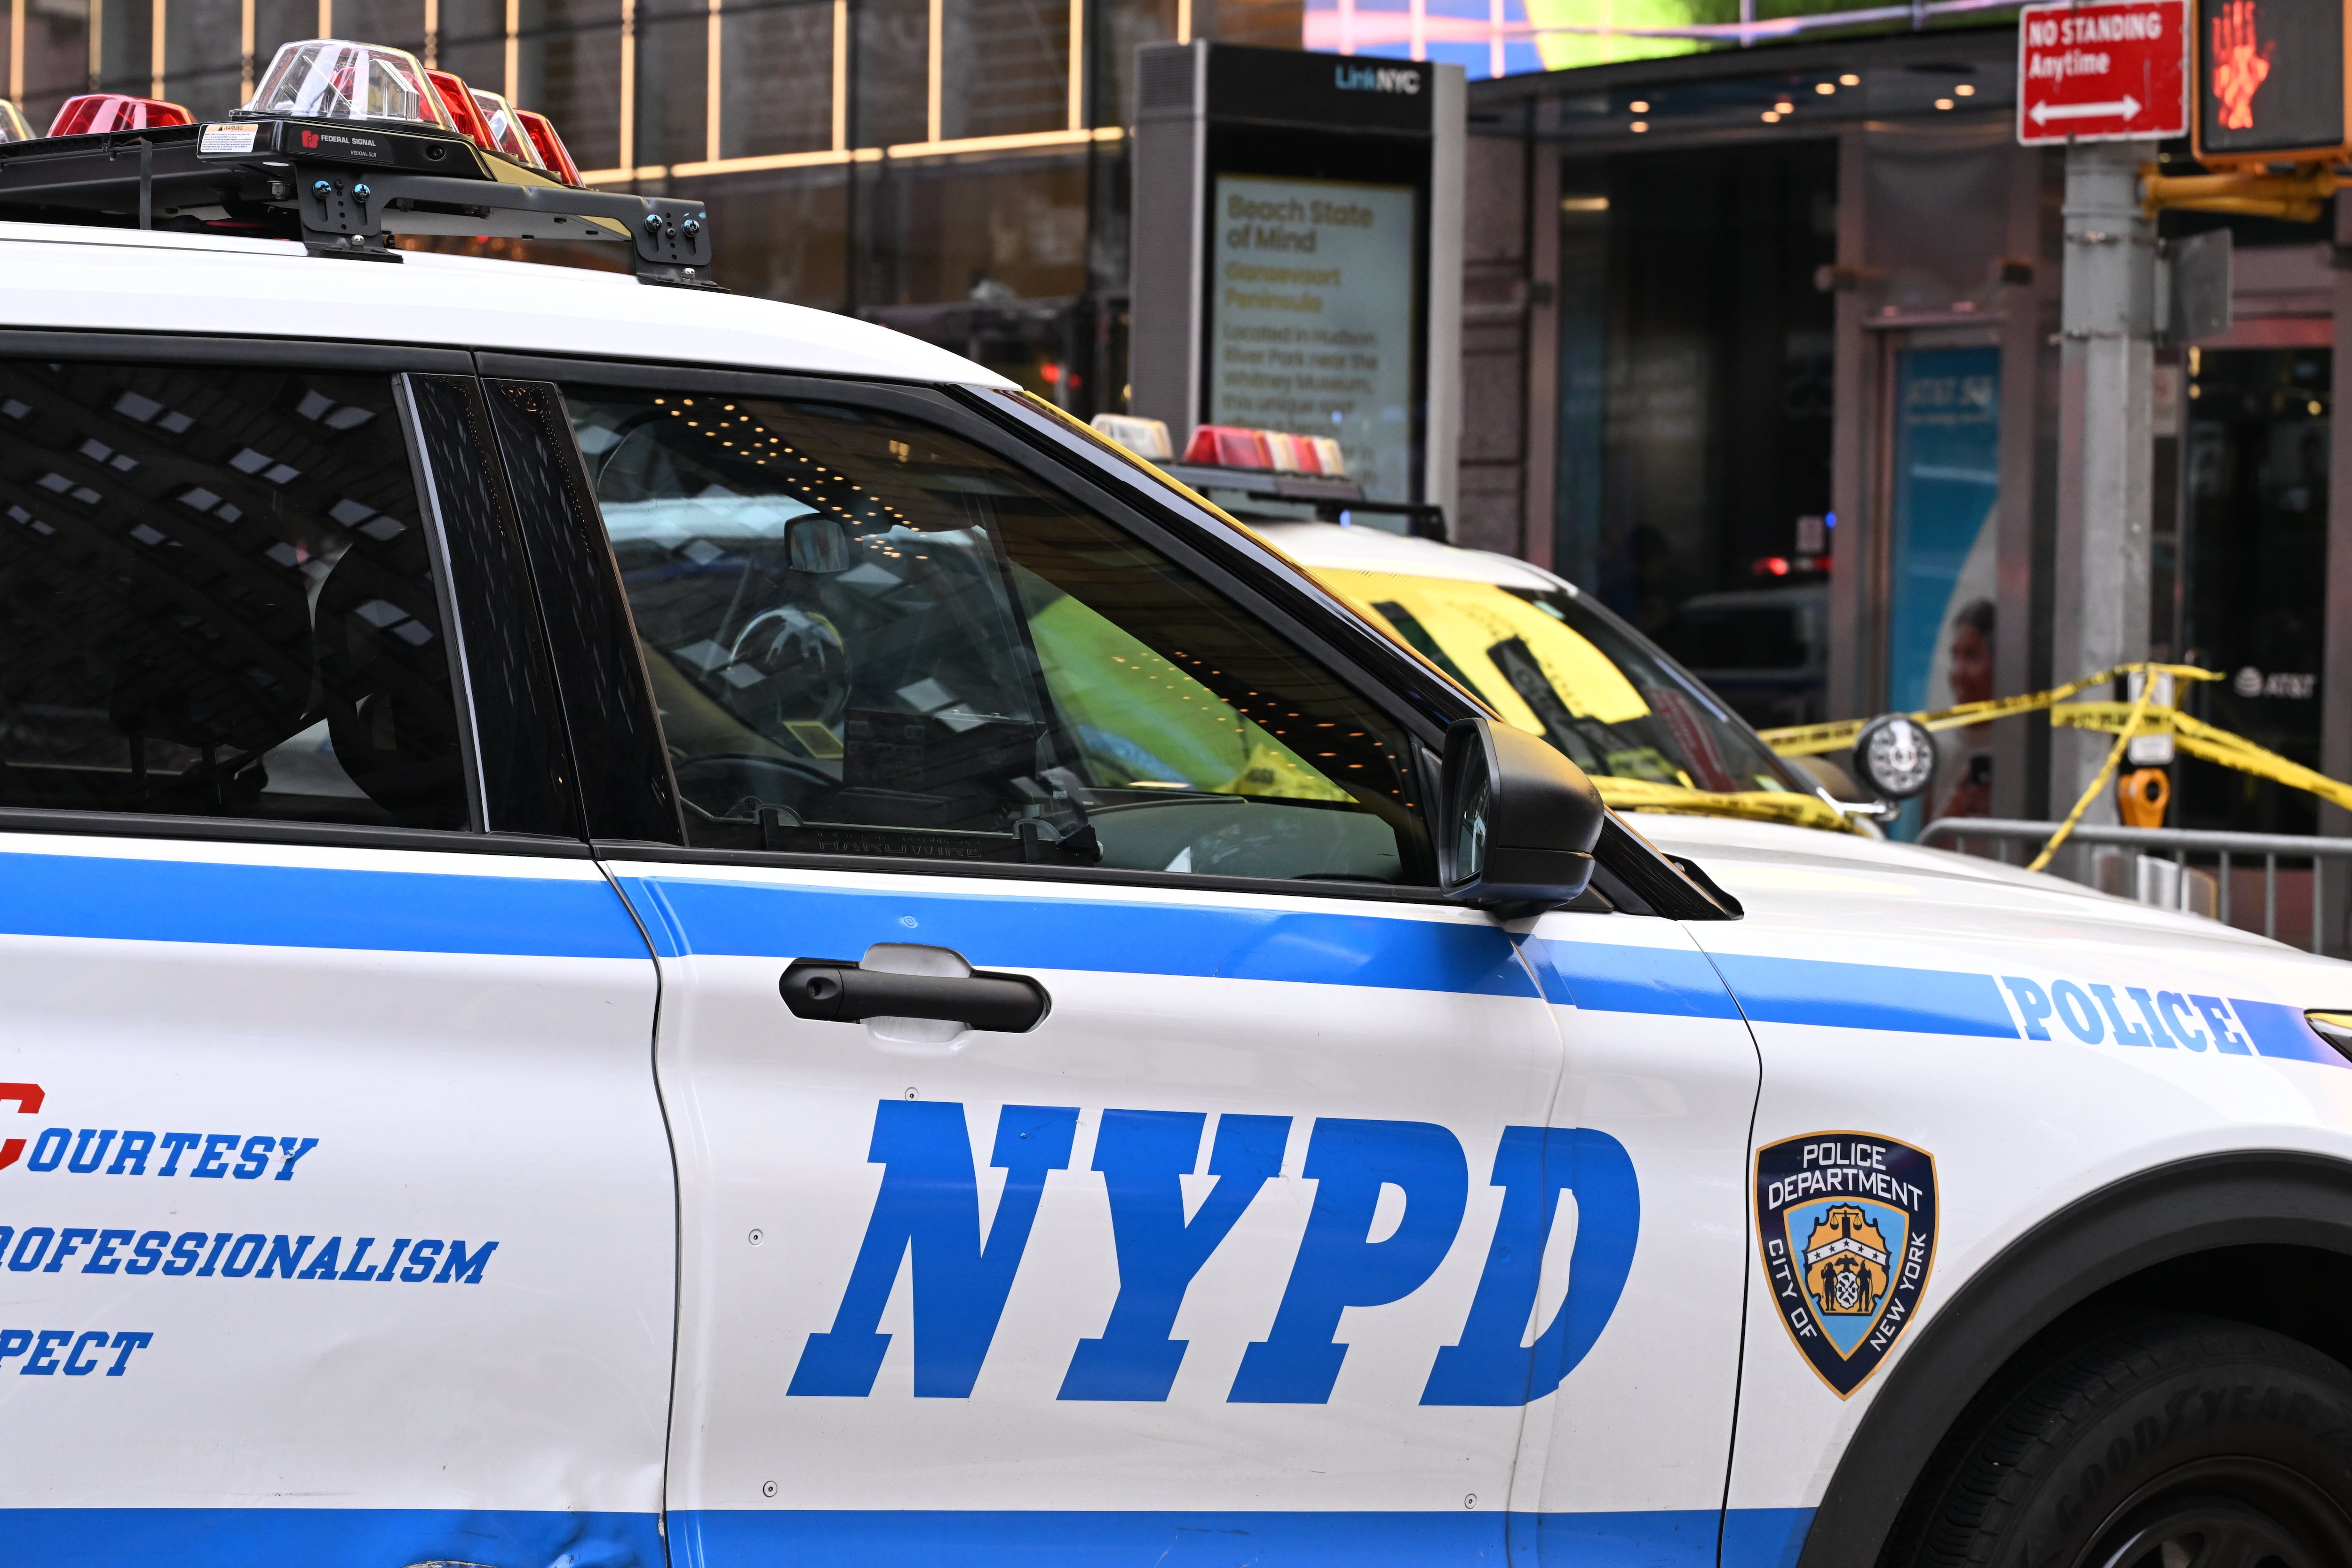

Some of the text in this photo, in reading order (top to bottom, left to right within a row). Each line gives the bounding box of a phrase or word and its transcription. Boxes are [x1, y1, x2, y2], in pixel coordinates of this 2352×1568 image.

[2029, 12, 2162, 47] NO STANDING
[1335, 64, 1420, 95] LinkNYC
[2029, 48, 2110, 82] Anytime
[321, 135, 376, 146] FEDERAL SIGNAL
[1228, 194, 1373, 228] Beach State
[1226, 225, 1316, 254] of Mind
[2001, 975, 2253, 1056] POLICE
[1803, 1143, 1886, 1170] POLICE
[1768, 1168, 1923, 1212] DEPARTMENT
[786, 1099, 1640, 1406] NYPD
[1768, 1232, 1926, 1352] CITY OF NEW YORK
[2056, 1385, 2317, 1532] GOODYEAR
